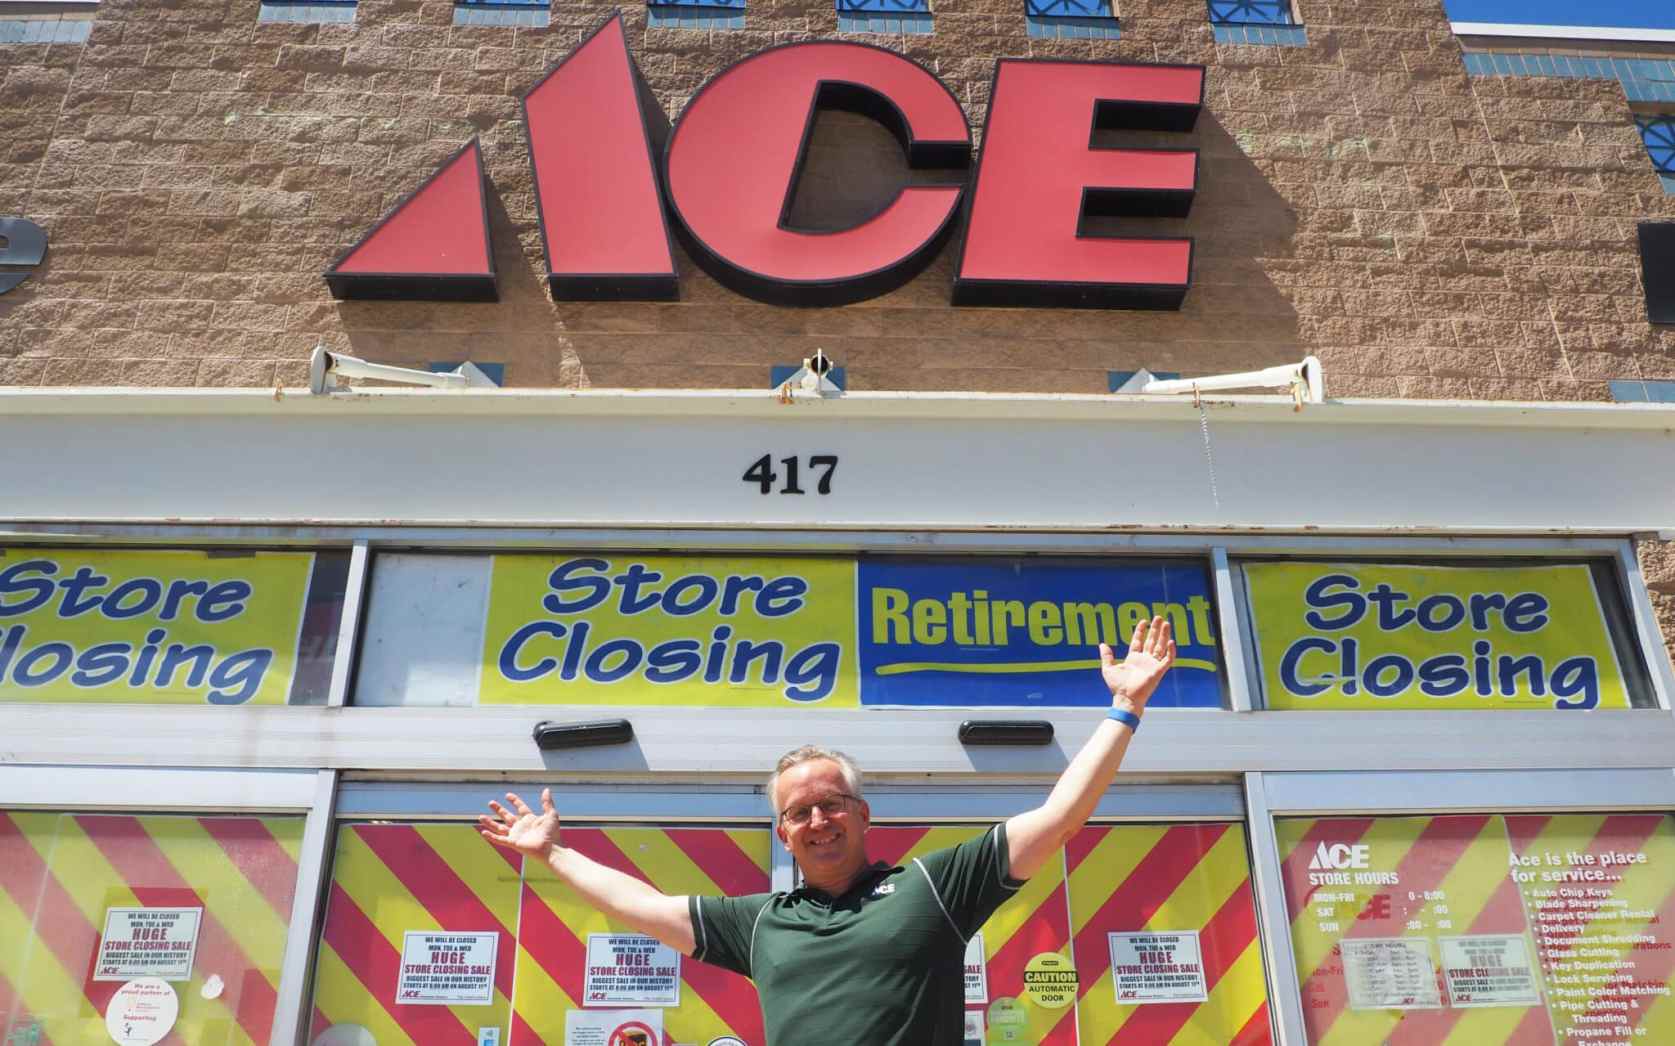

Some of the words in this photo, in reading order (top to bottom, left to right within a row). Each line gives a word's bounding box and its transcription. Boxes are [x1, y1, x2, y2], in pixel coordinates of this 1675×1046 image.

[325, 10, 1204, 306] ACE
[742, 453, 839, 495] 417
[0, 559, 252, 622] Store
[543, 558, 807, 617] Store
[1305, 574, 1549, 633] Store
[871, 587, 1216, 647] Retirement
[0, 624, 273, 705] losing
[499, 621, 841, 701] Closing
[1280, 637, 1599, 710] Closing
[1308, 840, 1370, 869] ACE
[1509, 852, 1540, 866] Ace
[1546, 852, 1562, 866] is
[1567, 851, 1596, 866] the
[1600, 851, 1648, 868] place
[1309, 872, 1352, 886] STORE
[1354, 872, 1400, 884] HOURS
[1511, 868, 1536, 882] for
[1541, 868, 1622, 882] service...
[1532, 888, 1558, 897] Auto
[1560, 888, 1584, 898] Chip
[1586, 887, 1614, 898] Keys
[1536, 900, 1565, 908] Blade
[1538, 911, 1575, 922] Carpet
[1577, 911, 1617, 920] Cleaner
[132, 928, 168, 940] HUGE
[1542, 924, 1585, 934] Delivery
[105, 941, 132, 950] STORE
[134, 941, 170, 950] CLOSING
[171, 941, 192, 950] SALE
[1544, 936, 1600, 945] Document
[431, 952, 466, 964] HUGE
[1139, 952, 1173, 963] HUGE
[1580, 948, 1620, 957] Cutting
[616, 954, 650, 966] HUGE
[405, 964, 431, 974] STORE
[433, 965, 470, 974] CLOSING
[471, 965, 491, 975] SALE
[590, 967, 617, 976] STORE
[618, 967, 654, 976] CLOSING
[656, 967, 676, 976] SALE
[1117, 965, 1142, 974] STORE
[1144, 964, 1179, 973] CLOSING
[1180, 964, 1200, 973] SALE
[1550, 963, 1571, 971] Key
[1574, 961, 1636, 970] Duplication
[1025, 972, 1076, 982] CAUTION
[1448, 968, 1476, 978] STORE
[1556, 988, 1585, 996] Paint
[1588, 988, 1615, 996] Color
[1620, 986, 1671, 996] Matching
[1560, 1002, 1584, 1010] Pipe
[1588, 1000, 1628, 1010] Cutting
[1572, 1014, 1628, 1024] Threading
[1566, 1028, 1612, 1037] Propane
[1616, 1026, 1632, 1036] Fill
